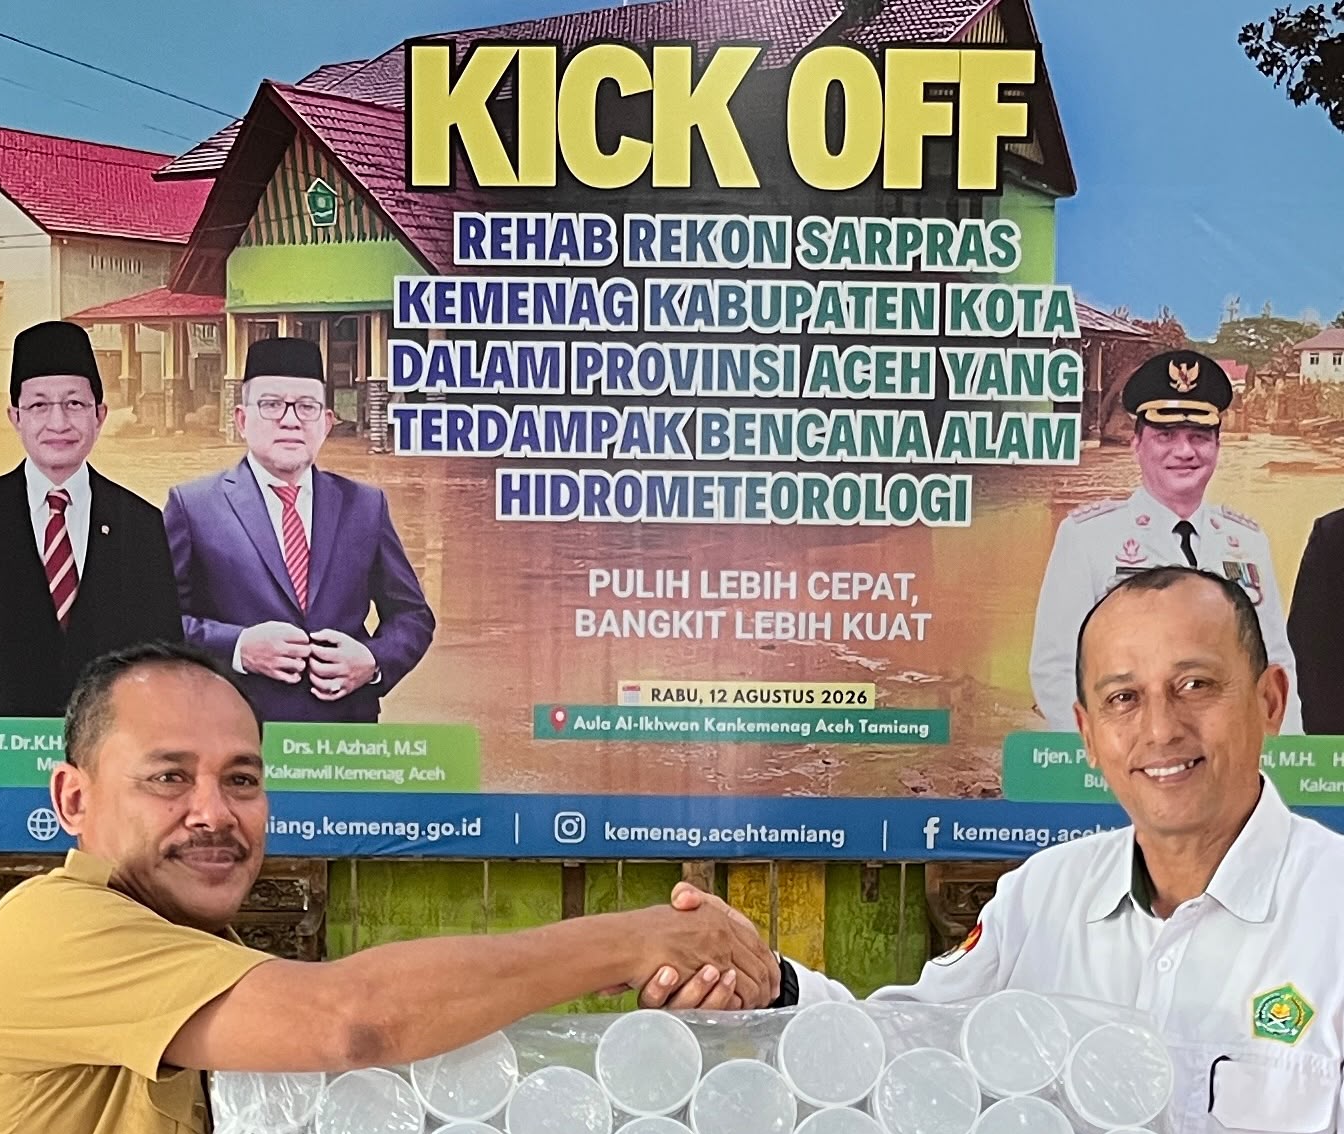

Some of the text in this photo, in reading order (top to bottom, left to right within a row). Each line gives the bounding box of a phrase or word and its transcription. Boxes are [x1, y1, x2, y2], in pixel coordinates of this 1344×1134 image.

[411, 43, 1036, 191] KICK OFF
[456, 214, 1021, 271] REHAB REKON SARPRAS
[396, 278, 1078, 337] KEMENAG KABUPATEN KOTA
[390, 342, 1081, 400] DALAM PROVINSI ACEH YANG
[390, 406, 1078, 462] TERDAMPAK BENCANA ALAM
[498, 471, 970, 525] HIDROMETEOROLOGI
[588, 568, 919, 607] PULIH LEBIH CEPAT,
[575, 608, 932, 642] BANGKIT LEBIH KUAT
[651, 687, 868, 706] RABU, 12 AGUSTUS 2026
[573, 715, 929, 739] Aula Al-Ikhwan Kankemenag Aceh Tamiang
[283, 739, 313, 755] Drs.
[316, 740, 333, 755] H.
[336, 739, 391, 758] Azhari,
[1033, 747, 1073, 769] Irjen.
[264, 764, 446, 785] Kakanwil Kemenag Aceh
[604, 821, 846, 848] kemenag.acehtamiang
